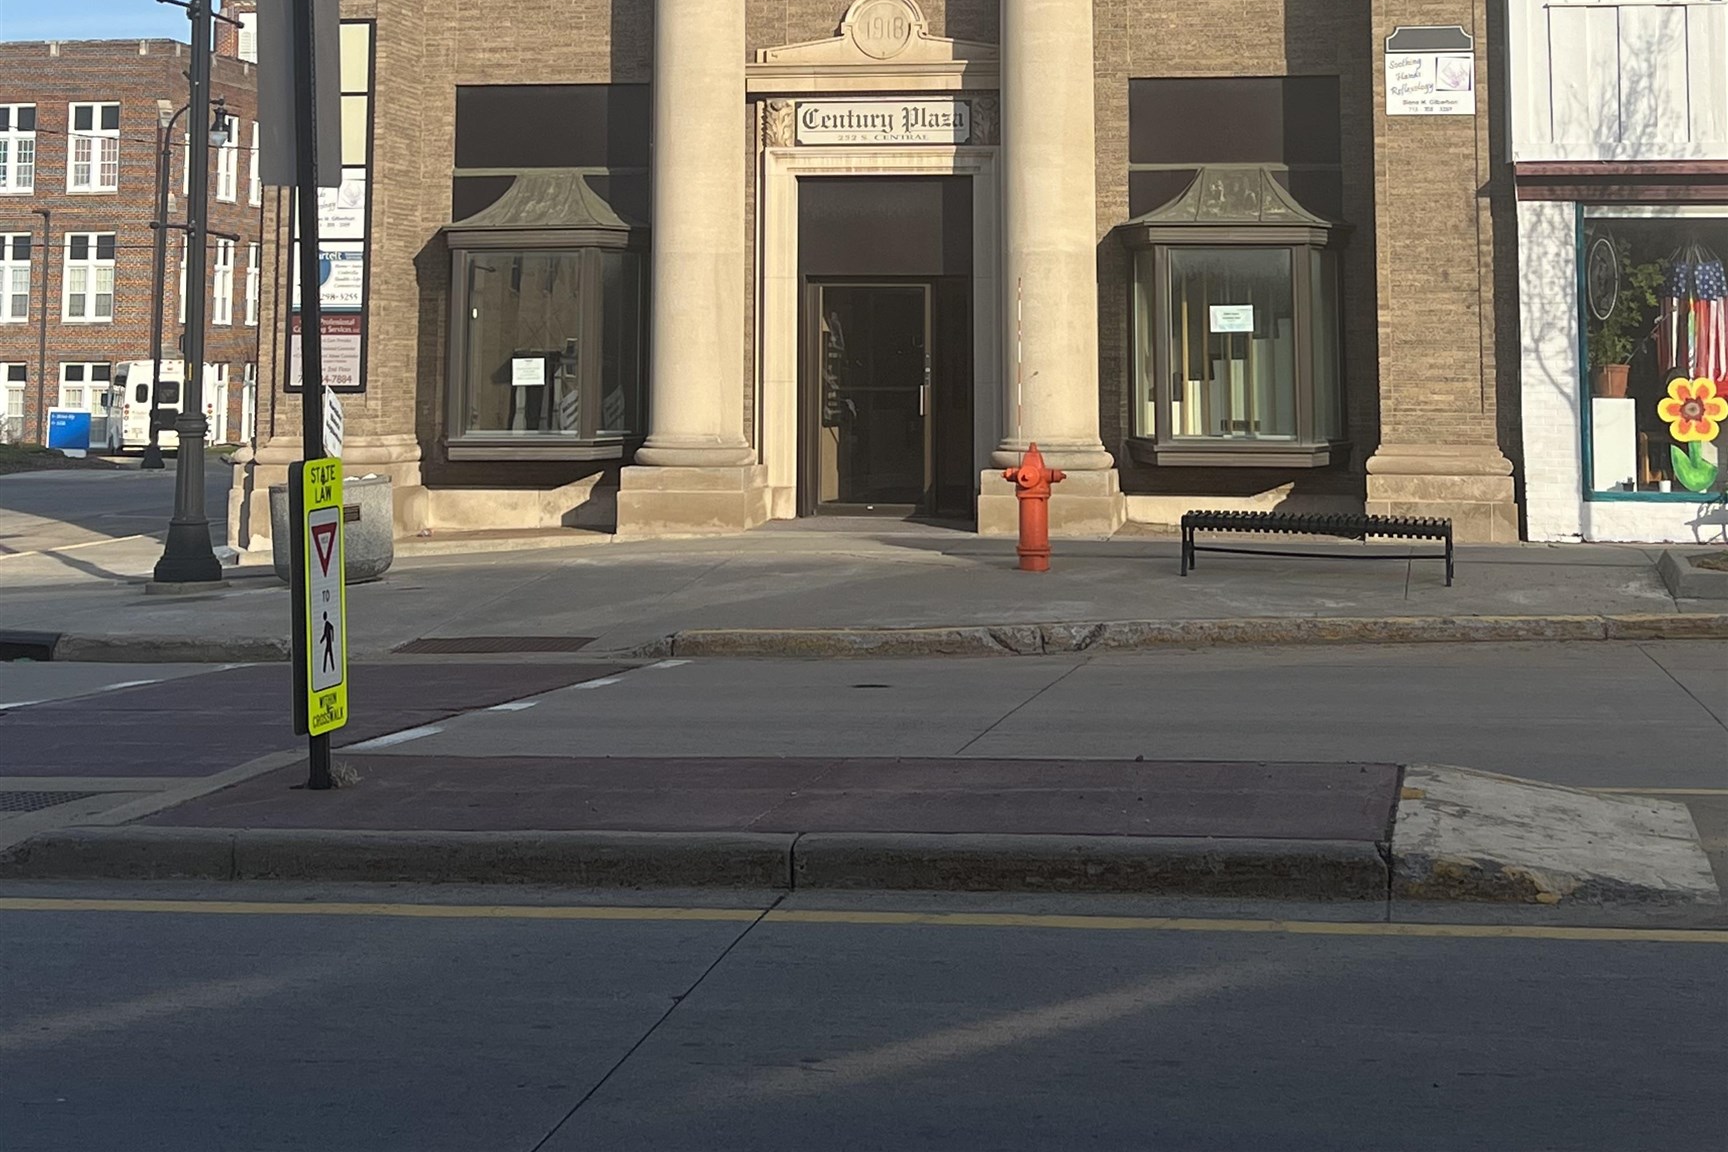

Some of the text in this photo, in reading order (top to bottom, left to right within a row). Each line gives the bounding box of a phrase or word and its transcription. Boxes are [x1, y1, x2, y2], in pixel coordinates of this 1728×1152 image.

[866, 16, 904, 40] 1918
[802, 106, 965, 134] Century Plaza
[874, 133, 929, 142] CENTRAL
[311, 464, 336, 485] STATE
[315, 485, 332, 504] LAW
[322, 589, 331, 603] TO
